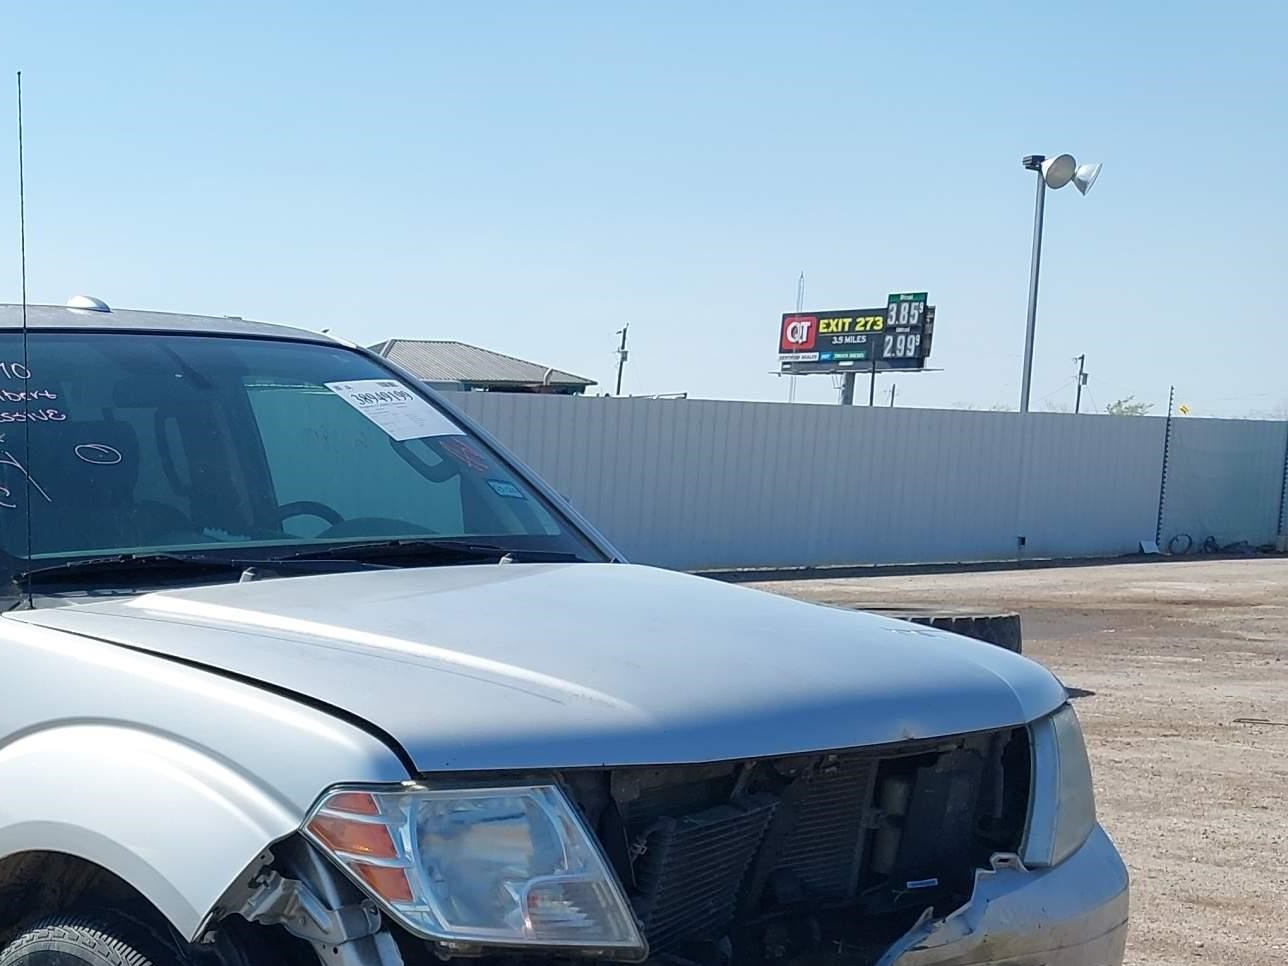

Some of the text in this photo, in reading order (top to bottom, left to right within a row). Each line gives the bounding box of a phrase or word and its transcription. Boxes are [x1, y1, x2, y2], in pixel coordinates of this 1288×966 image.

[786, 321, 811, 345] QT
[819, 316, 884, 333] EXIT 273
[832, 335, 867, 344] 3.5 MILES
[351, 389, 414, 406] 38949199
